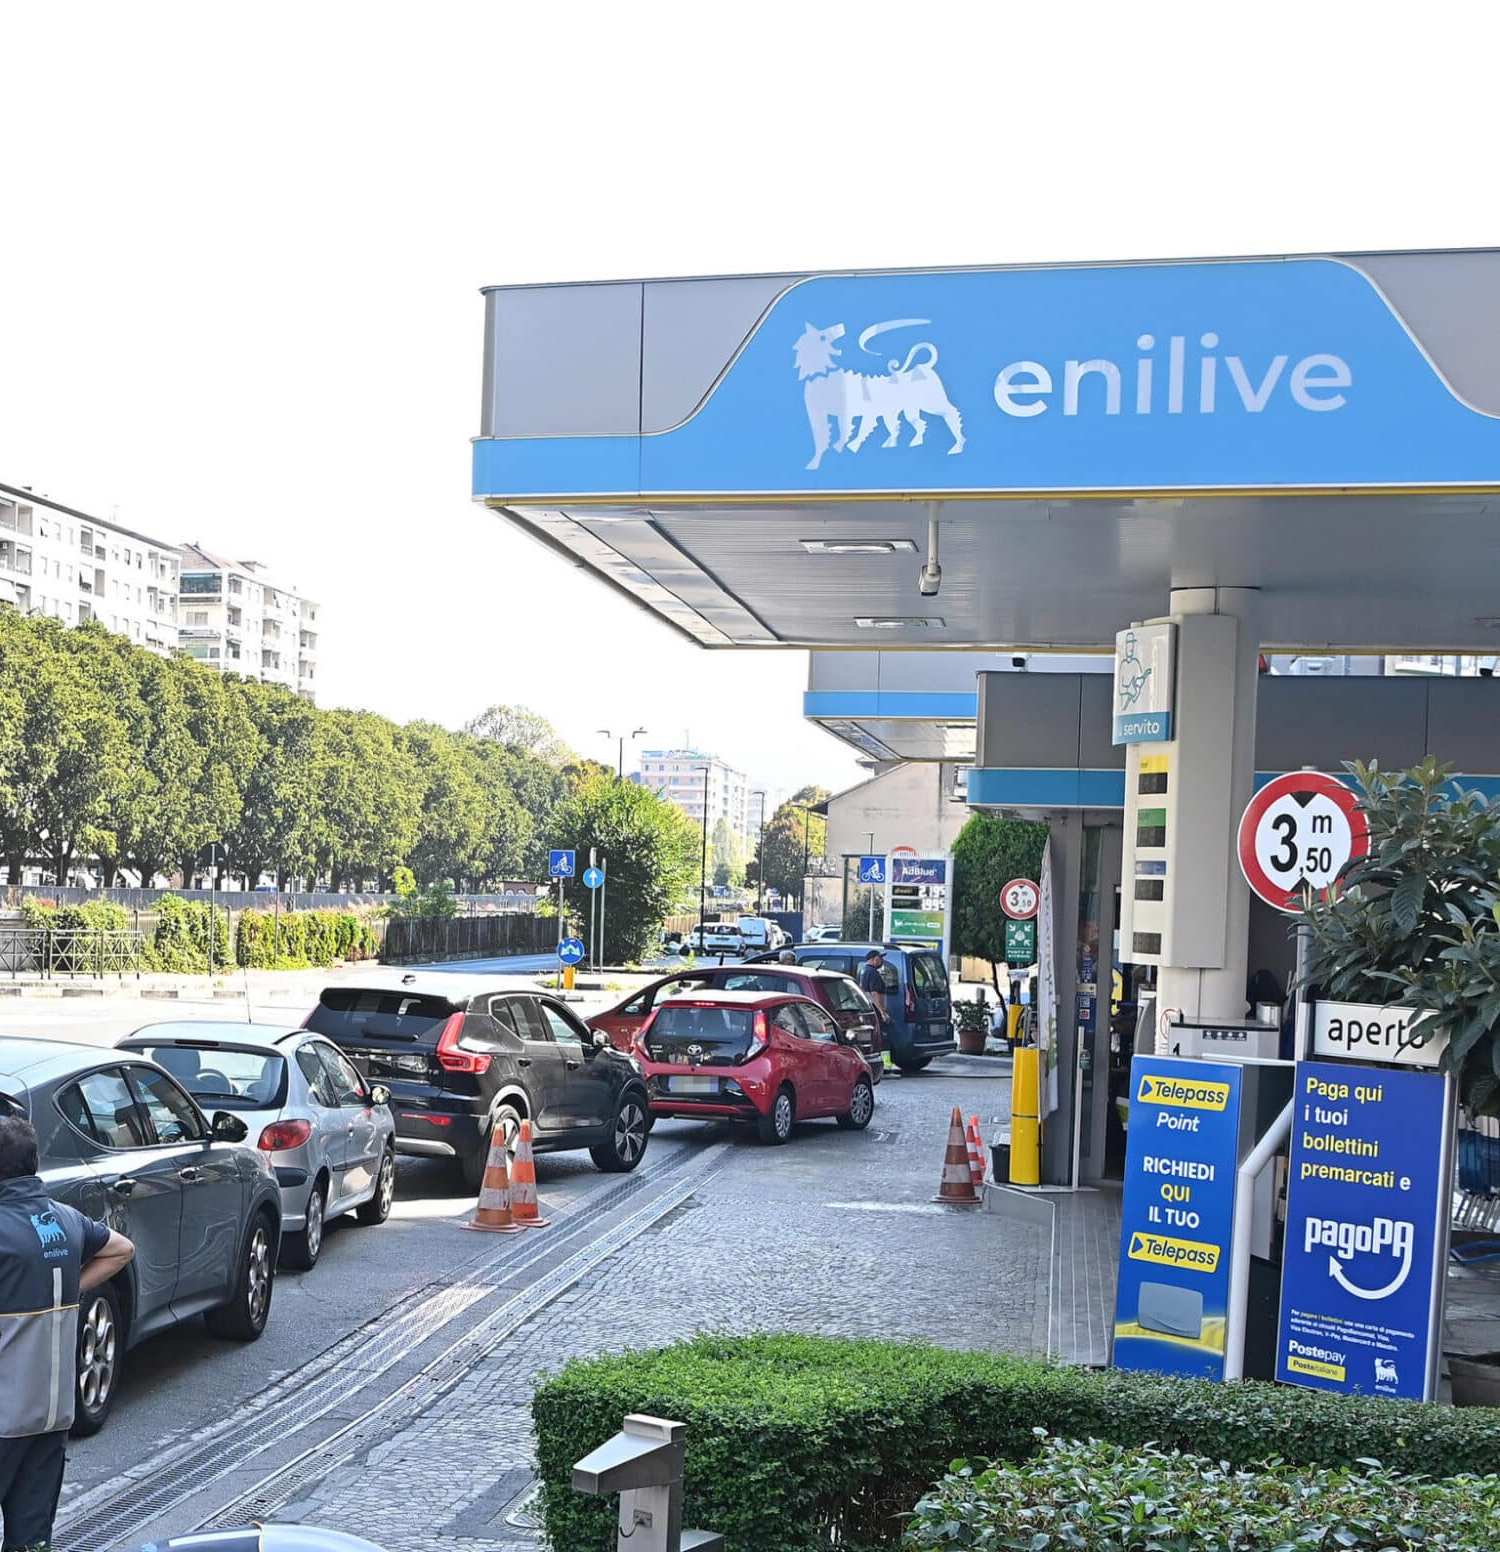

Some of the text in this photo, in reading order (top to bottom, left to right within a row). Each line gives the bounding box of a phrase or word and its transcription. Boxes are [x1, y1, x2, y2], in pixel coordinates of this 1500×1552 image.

[993, 332, 1352, 417] enilive
[1123, 718, 1160, 736] servito
[1155, 1080, 1225, 1106] Telepass
[1306, 1077, 1383, 1104] Paga qui
[1156, 1111, 1200, 1132] Point
[1304, 1104, 1348, 1126] i tuoi
[1303, 1132, 1380, 1158] bollettini
[1143, 1156, 1215, 1181] RICHIEDI
[1300, 1162, 1411, 1191] premarcati e
[1160, 1184, 1190, 1202] QUI
[1148, 1206, 1200, 1229] IL TUO
[1304, 1216, 1414, 1260] pagoPA
[43, 1246, 69, 1259] enilive
[1144, 1239, 1216, 1266] Telepass
[1288, 1339, 1346, 1366] Postepay
[1293, 1359, 1338, 1376] Posteitaliane
